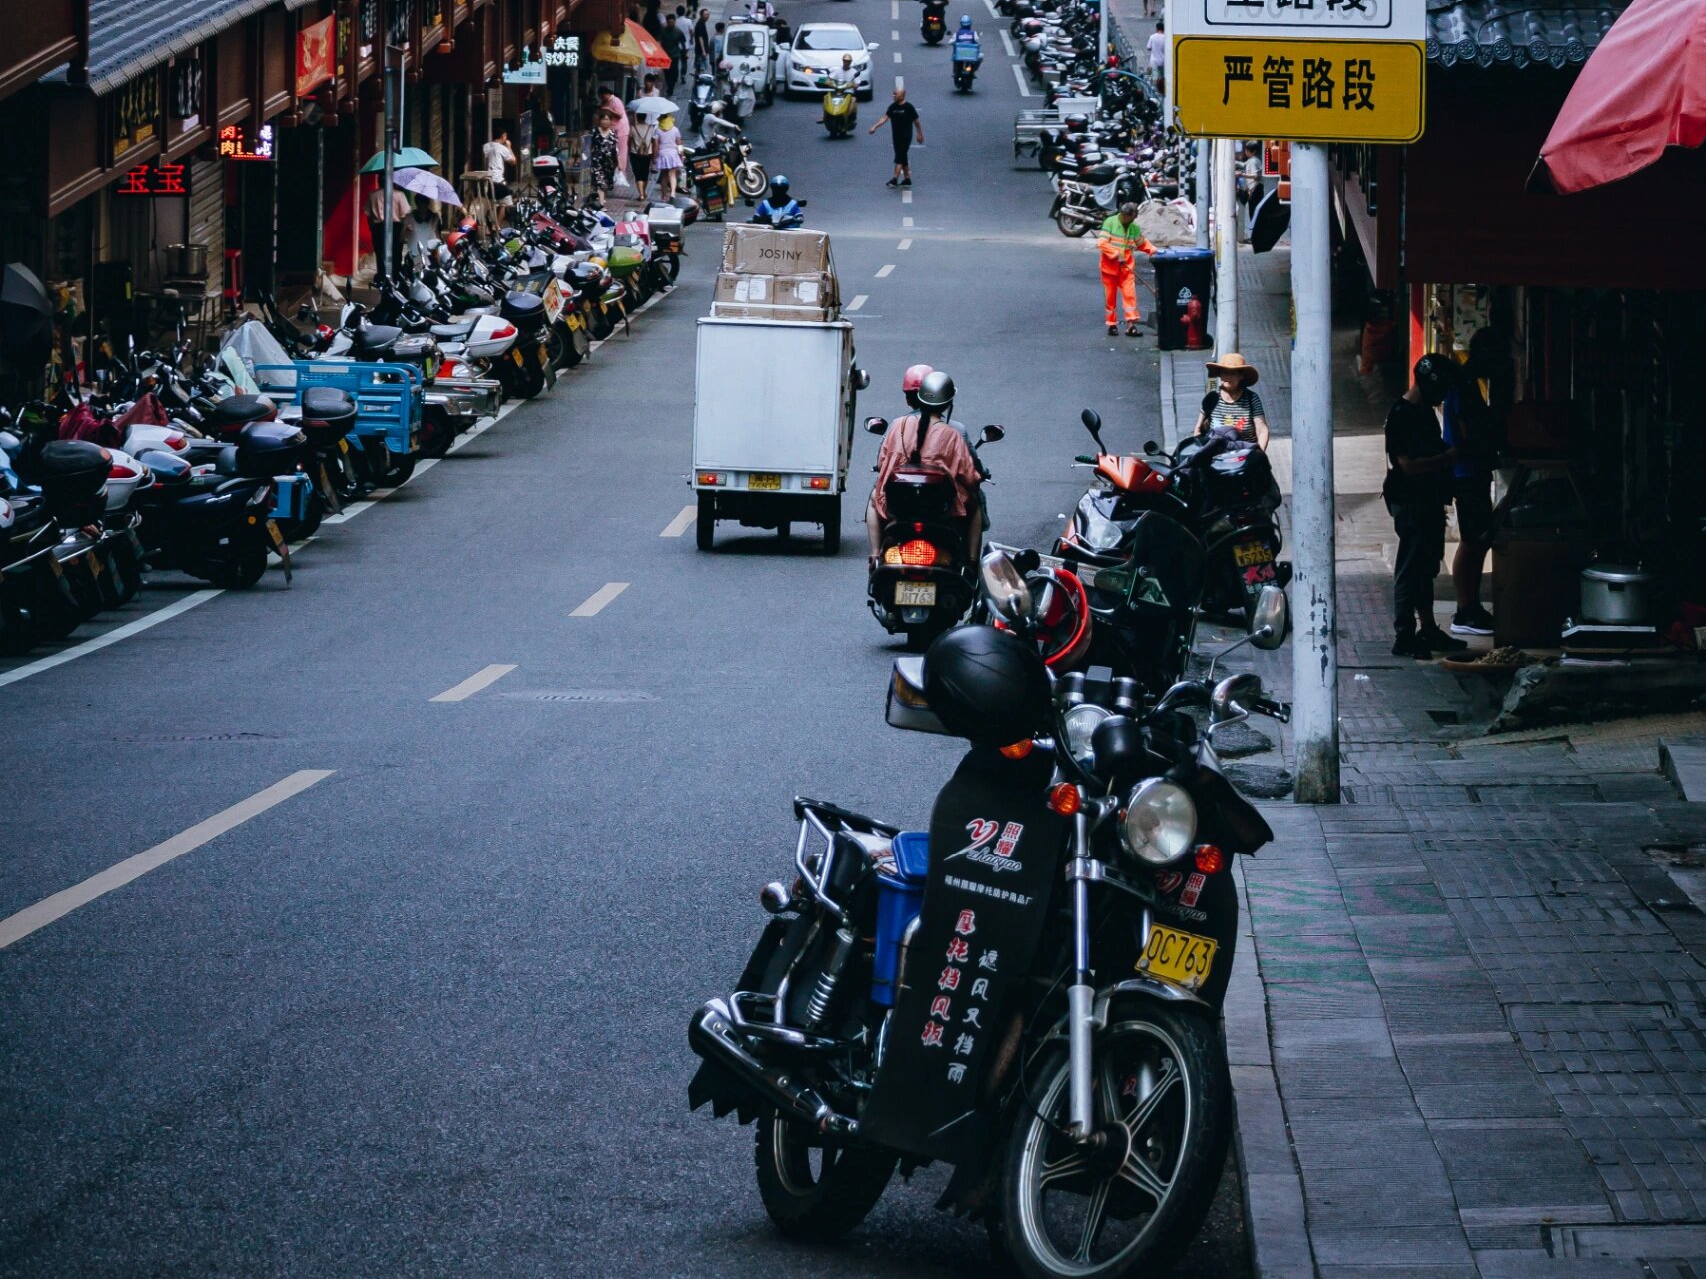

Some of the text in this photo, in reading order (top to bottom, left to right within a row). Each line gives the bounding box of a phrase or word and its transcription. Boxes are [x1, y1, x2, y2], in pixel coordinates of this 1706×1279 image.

[1222, 55, 1376, 112] 严管路段
[759, 249, 802, 260] JOSINY
[947, 948, 998, 1085] 遮风又挡雨
